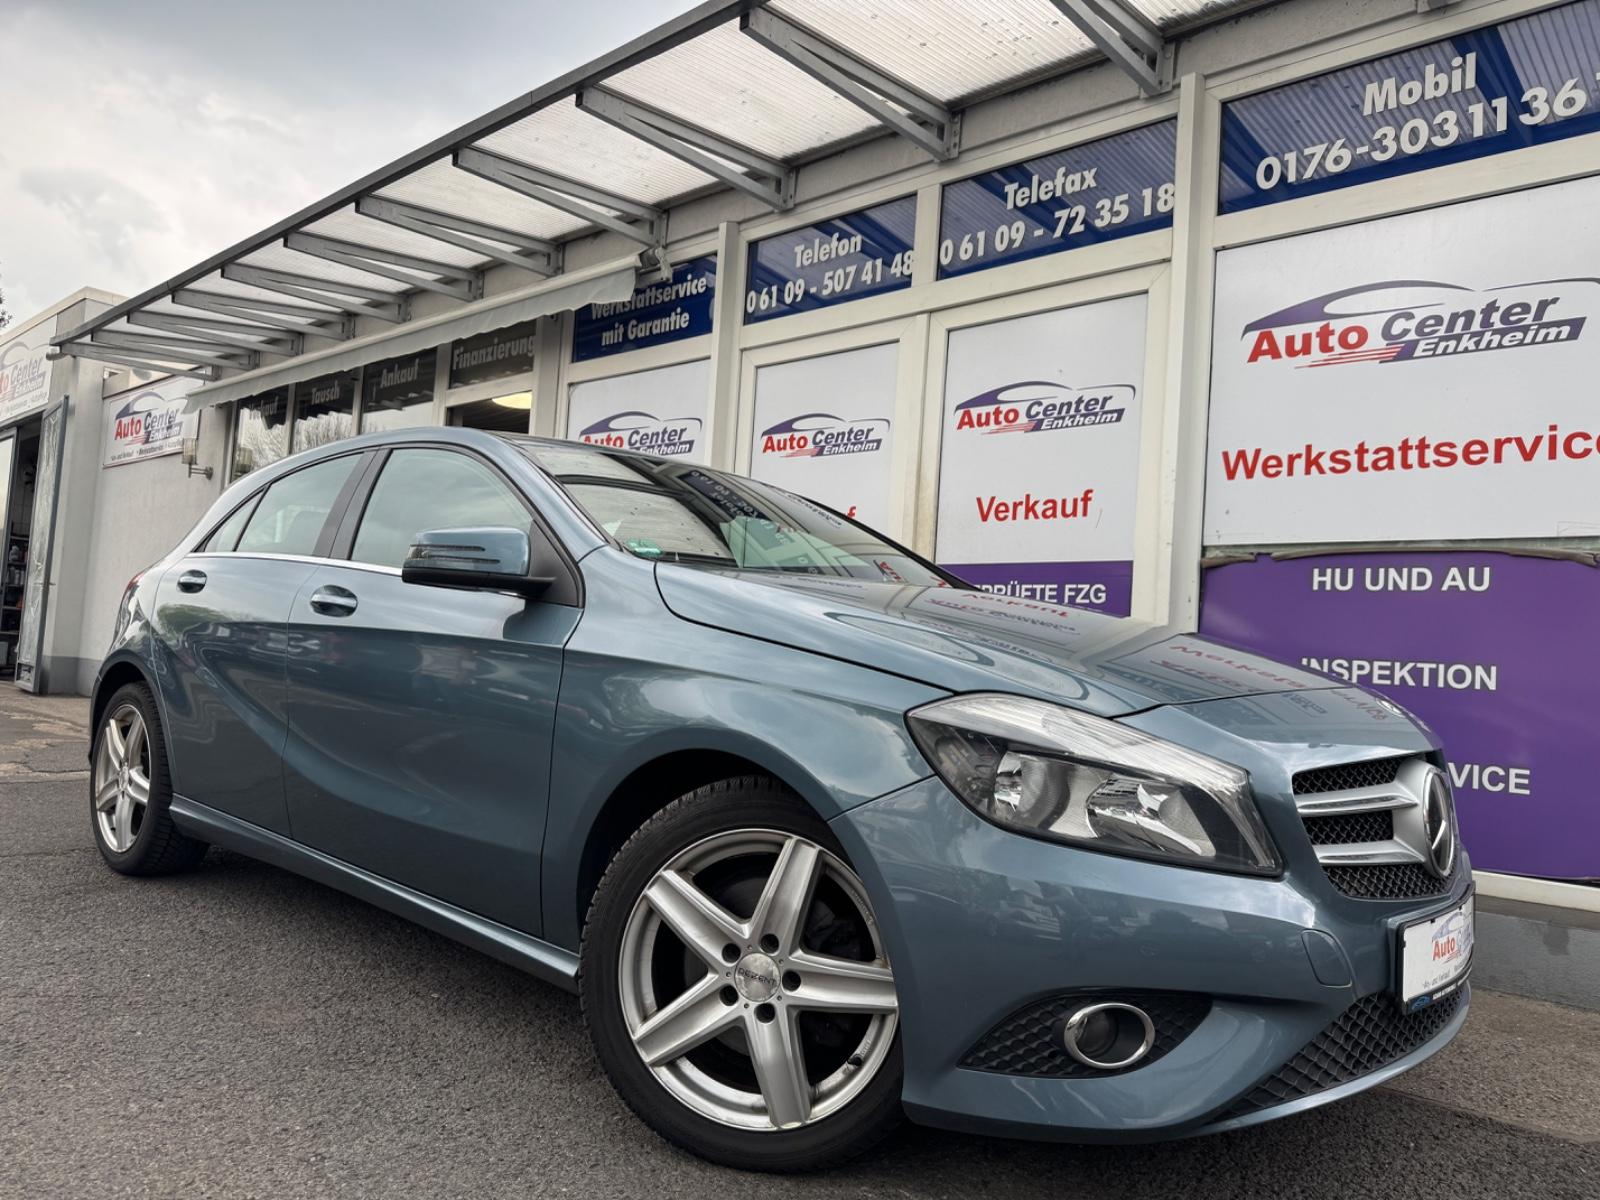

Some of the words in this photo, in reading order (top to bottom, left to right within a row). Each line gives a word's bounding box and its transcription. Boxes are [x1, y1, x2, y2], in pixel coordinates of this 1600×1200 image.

[1363, 51, 1477, 116] Mobil
[1004, 166, 1098, 210] Telefax
[995, 220, 1026, 253] 09
[1053, 205, 1086, 239] 72
[1094, 193, 1130, 228] 35
[1142, 182, 1175, 217] 18
[794, 232, 863, 268] Telefon
[784, 278, 806, 305] 09
[821, 264, 857, 296] 507
[861, 257, 883, 285] 41
[890, 250, 915, 279] 48
[591, 273, 707, 321] Werkstattservice
[601, 323, 625, 346] mit
[627, 307, 690, 340] Garantie
[1246, 321, 1369, 364] Auto
[1380, 296, 1561, 342] Center
[1411, 322, 1572, 360] Enkheim
[10, 355, 44, 385] Center
[452, 335, 535, 371] Finanzierung
[380, 358, 420, 388] Ankauf
[311, 379, 341, 405] Tausch
[114, 416, 142, 440] Auto
[143, 407, 180, 430] Center
[956, 406, 1020, 431] Auto
[1024, 394, 1114, 420] Center
[1040, 411, 1119, 430] Enkheim
[583, 433, 625, 448] to
[627, 426, 688, 447] Center
[762, 432, 809, 453] Auto
[811, 426, 874, 446] Center
[823, 442, 878, 456] Enkheim
[1222, 423, 1600, 481] Werkstattservic
[975, 488, 1094, 523] Verkauf
[1064, 583, 1107, 604] FZG
[1312, 567, 1354, 592] HU
[1364, 567, 1433, 592] UND
[1441, 566, 1491, 592] AU
[1431, 936, 1457, 961] Auto
